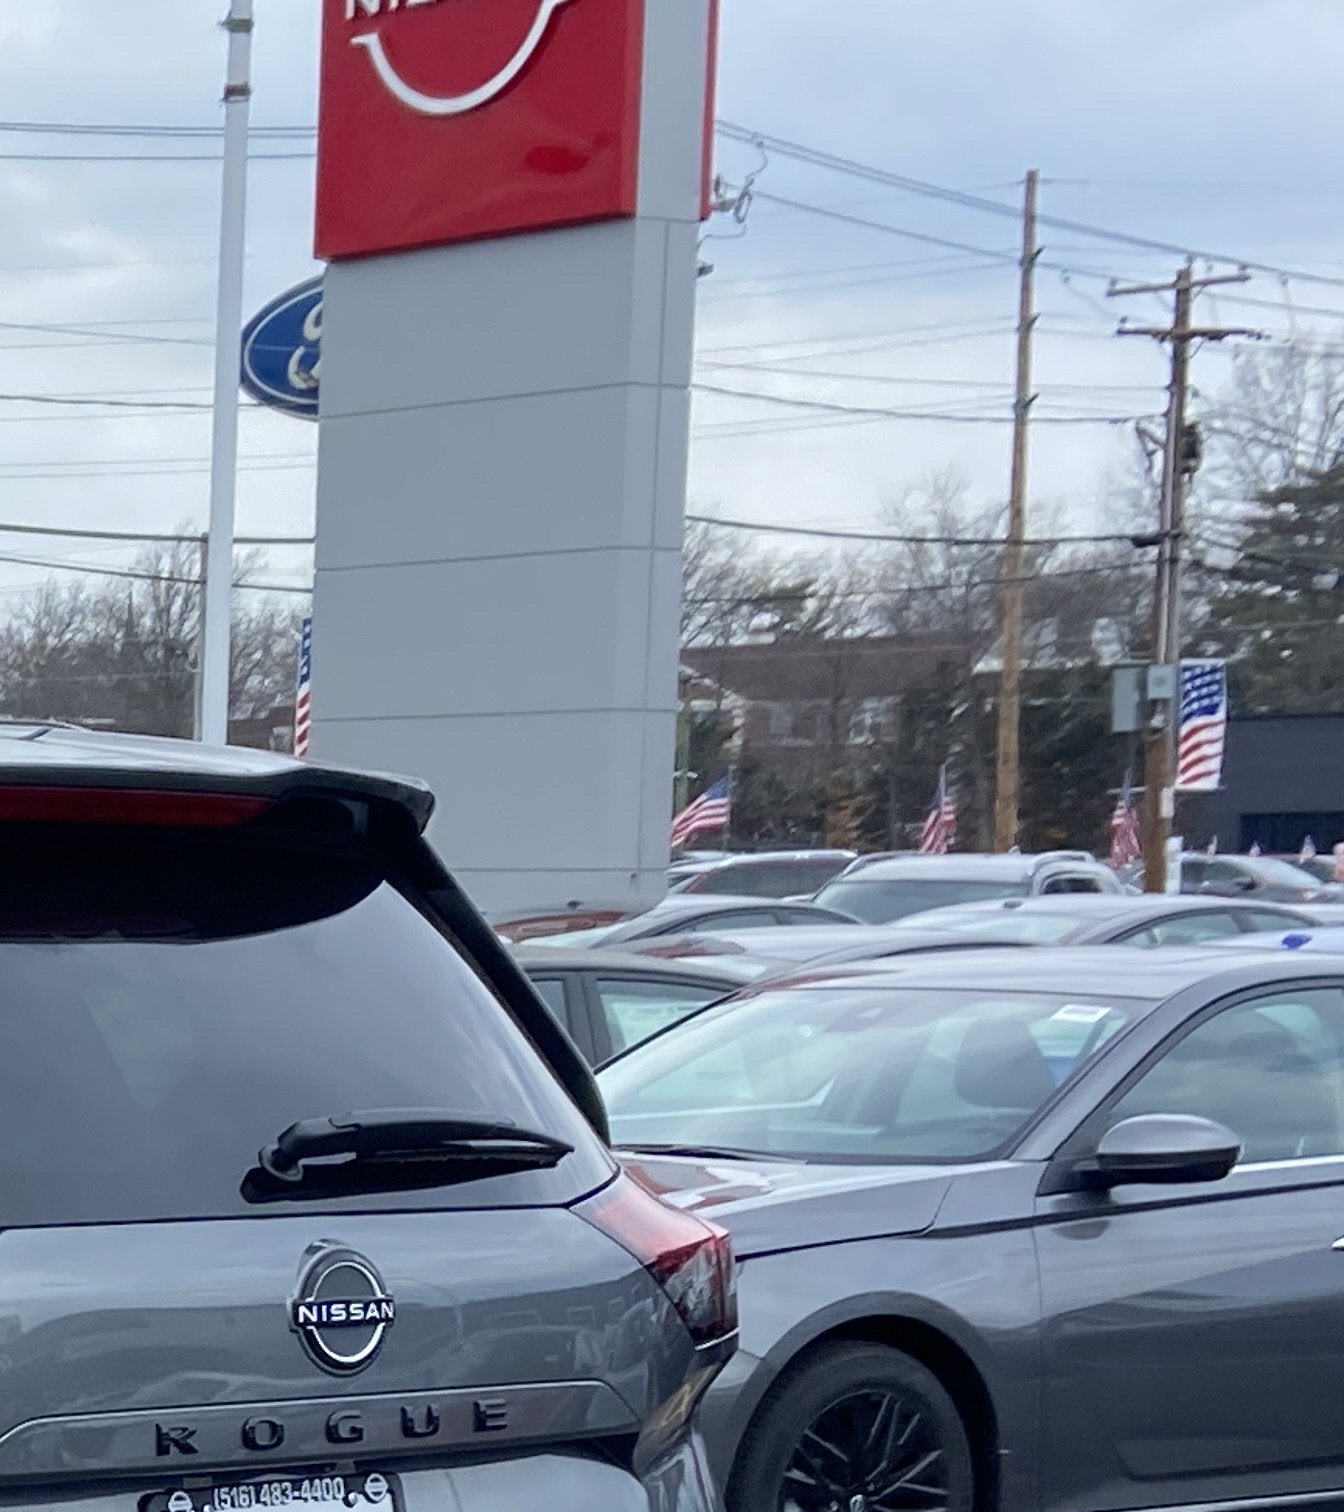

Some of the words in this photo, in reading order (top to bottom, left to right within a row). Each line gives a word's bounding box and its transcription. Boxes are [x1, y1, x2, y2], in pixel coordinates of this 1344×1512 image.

[298, 1302, 394, 1323] NISSAN
[155, 1400, 508, 1456] ROGUE
[213, 1484, 255, 1511] (516)
[259, 1477, 345, 1507] 483-4400
